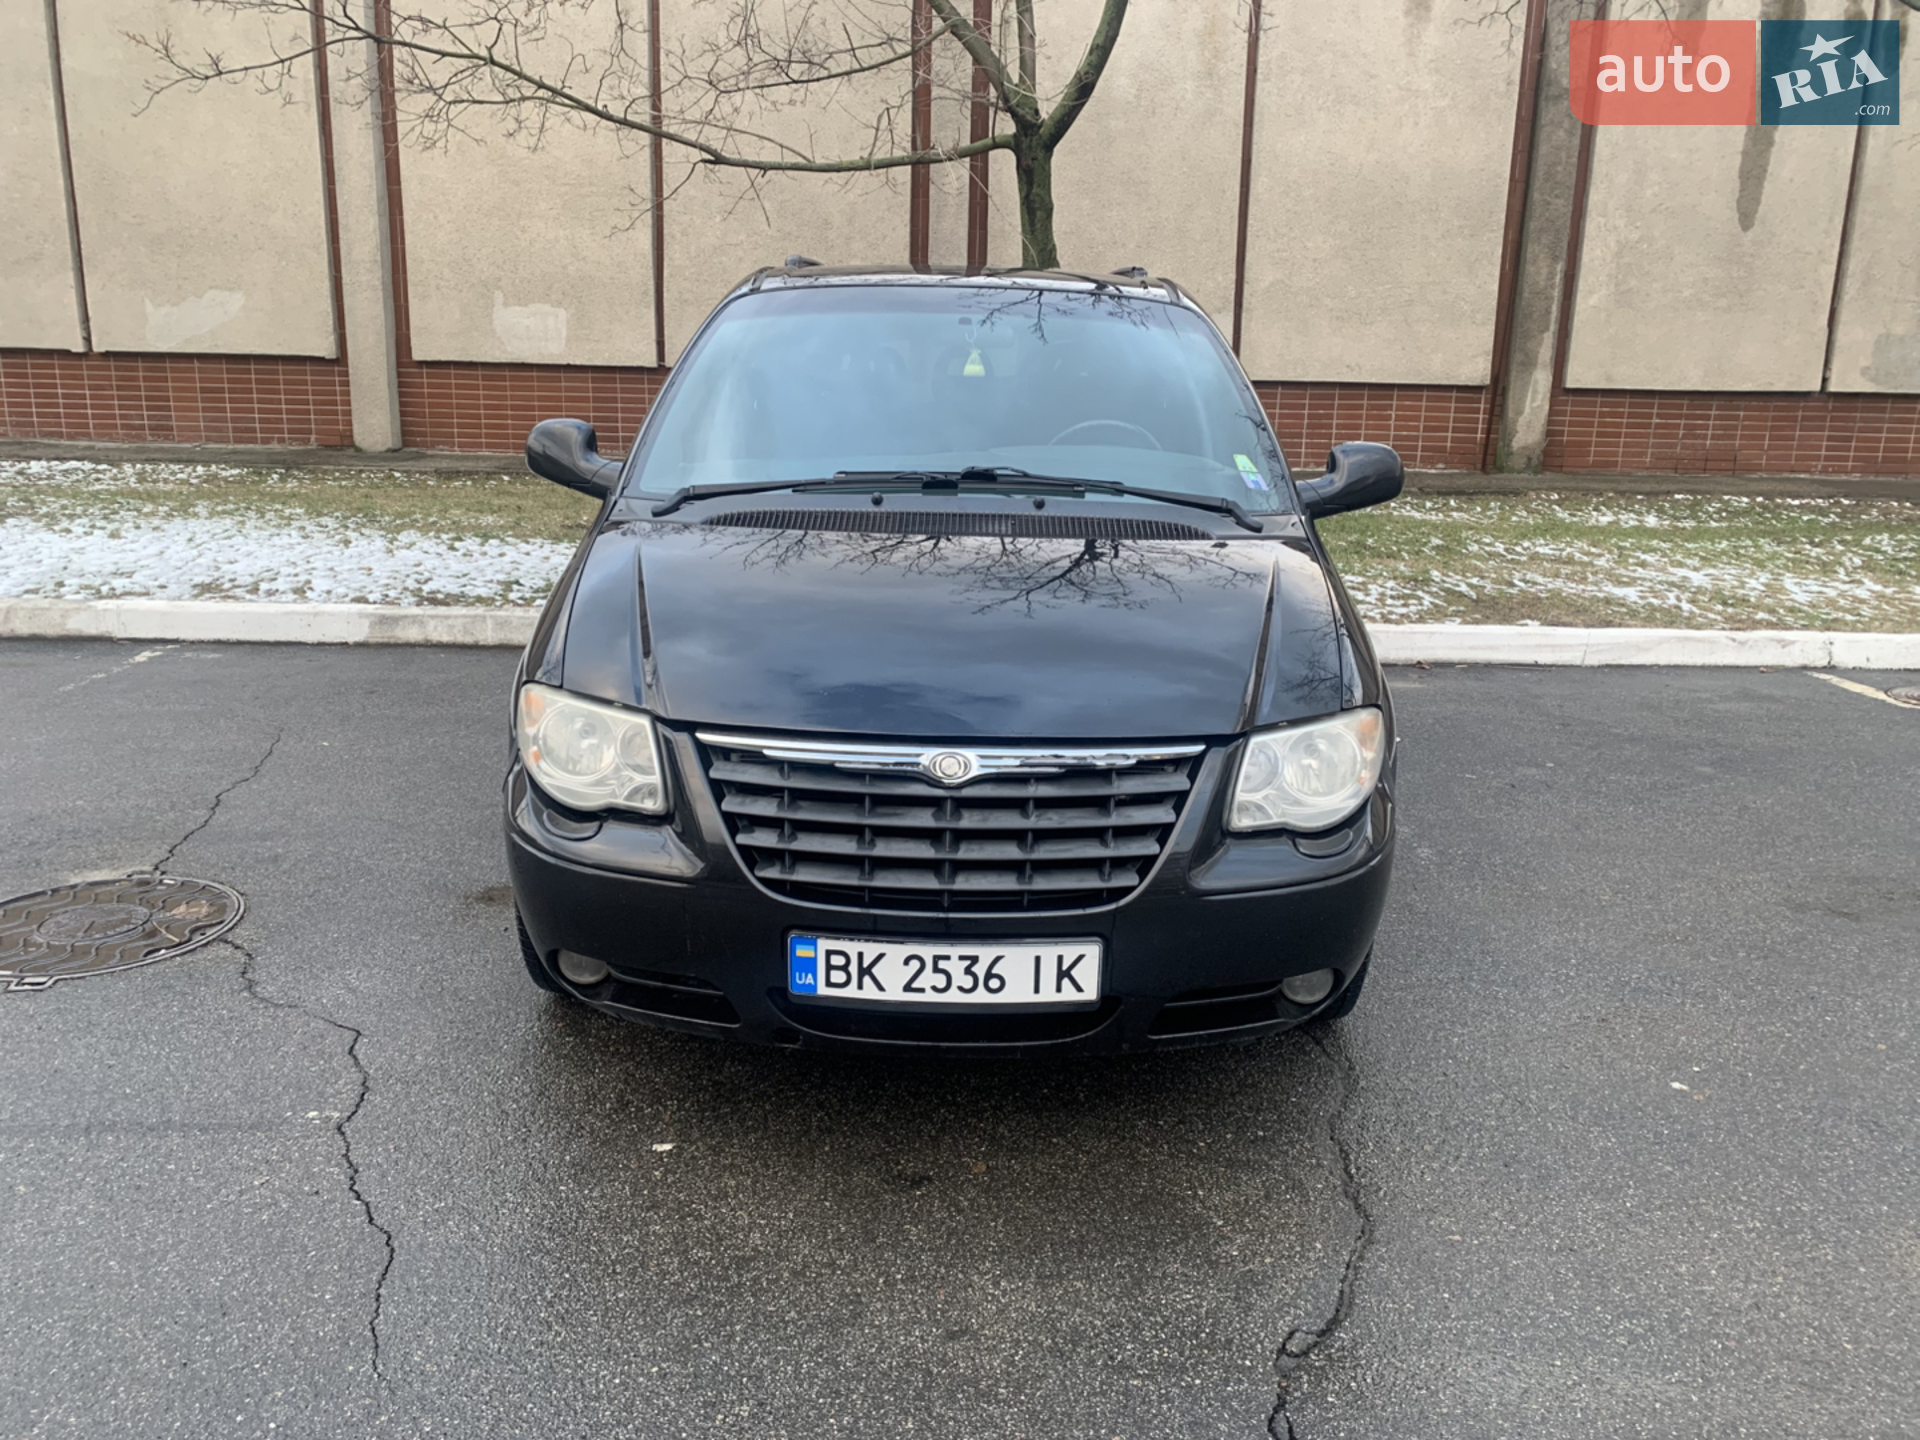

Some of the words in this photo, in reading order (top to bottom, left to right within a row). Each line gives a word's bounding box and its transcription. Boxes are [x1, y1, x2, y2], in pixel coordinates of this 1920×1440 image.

[795, 972, 815, 985] UA
[824, 949, 887, 992] BK
[902, 954, 1006, 994] 2536
[1033, 954, 1087, 994] IK
